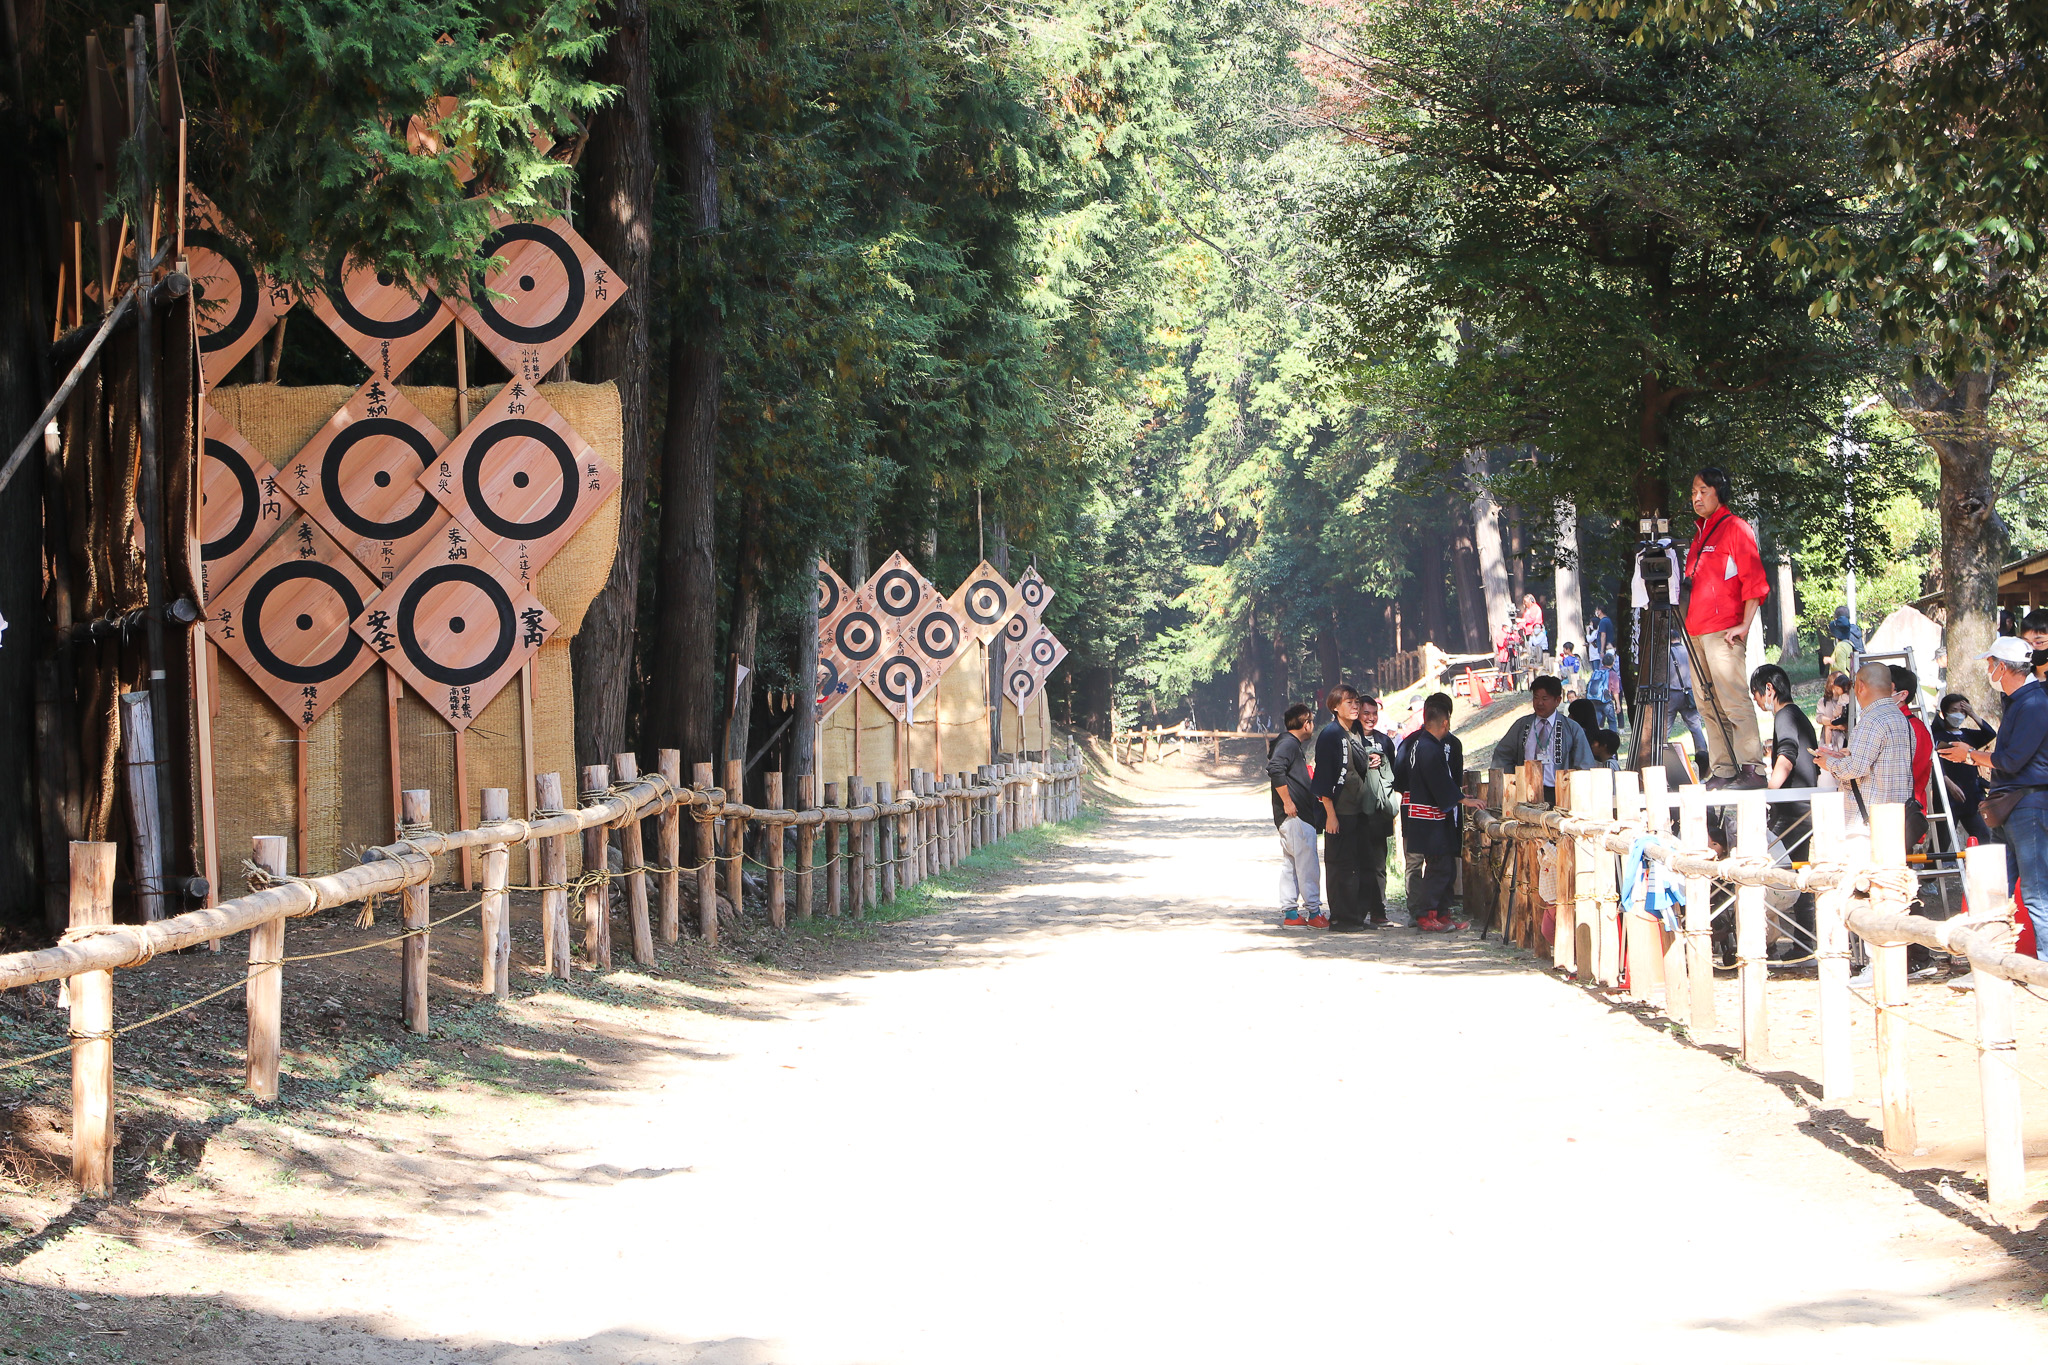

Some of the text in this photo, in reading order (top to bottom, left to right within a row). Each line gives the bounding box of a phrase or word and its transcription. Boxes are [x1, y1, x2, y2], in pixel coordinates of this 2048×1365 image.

[594, 269, 608, 301] 家内
[365, 381, 387, 417] 奉納
[507, 382, 527, 415] 奉納
[294, 463, 310, 497] 安全
[438, 461, 452, 495] 息災
[587, 463, 600, 491] 無病
[260, 475, 282, 521] 家内
[298, 521, 316, 559] 奉納
[448, 528, 467, 561] 奉納
[208, 608, 235, 639] 安全
[366, 610, 396, 653] 安全
[520, 608, 548, 649] 家内
